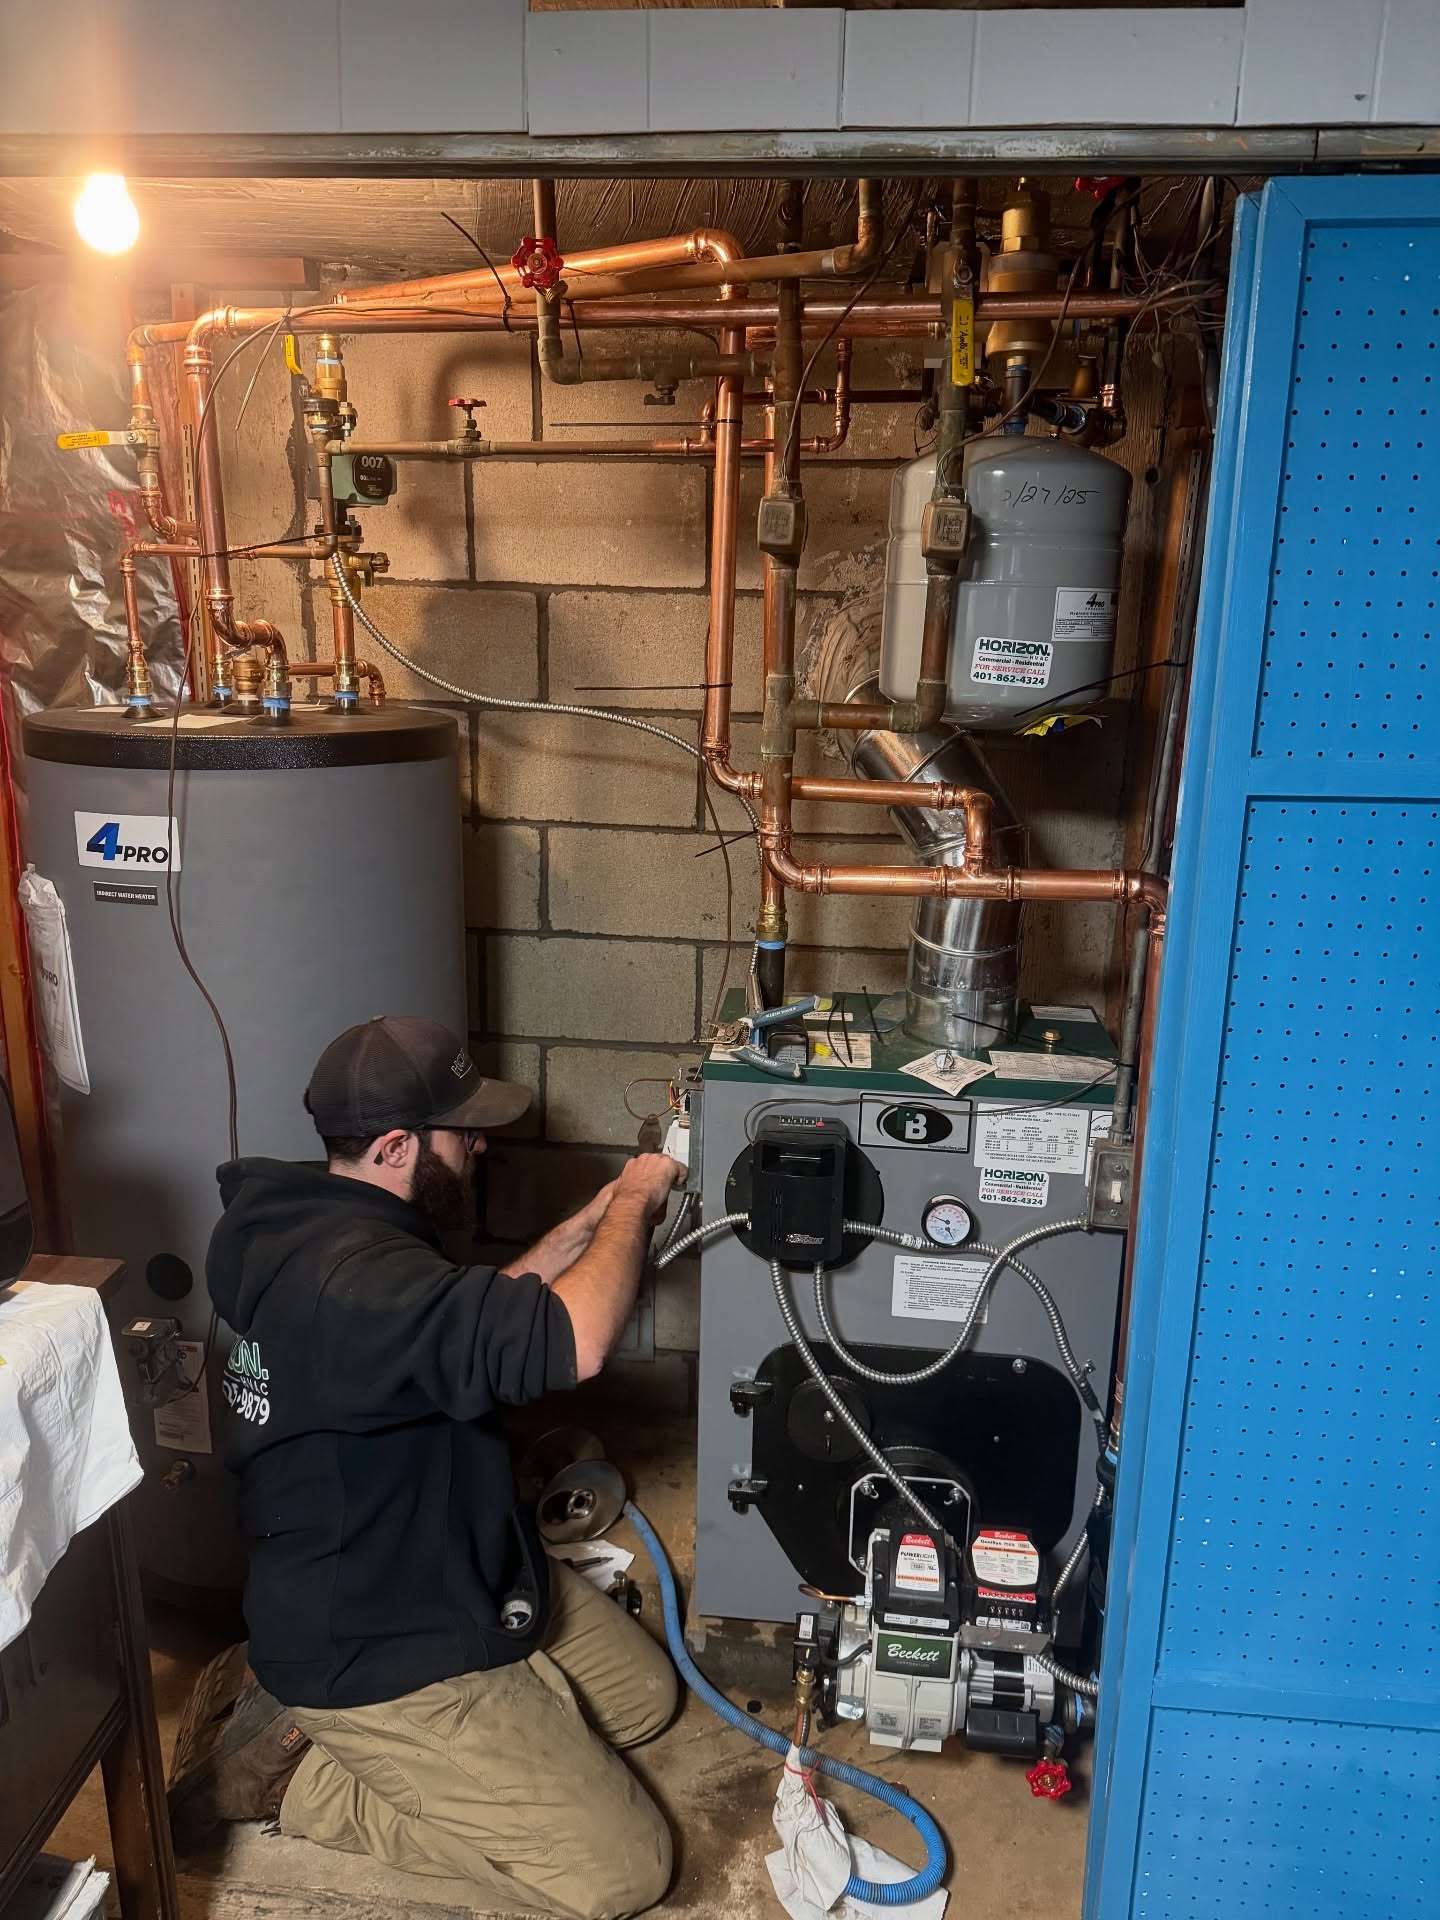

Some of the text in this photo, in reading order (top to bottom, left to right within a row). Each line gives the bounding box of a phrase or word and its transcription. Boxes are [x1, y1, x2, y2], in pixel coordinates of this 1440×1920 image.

[978, 656, 1012, 664] Commercial
[1014, 659, 1045, 667] Residential
[991, 665, 1026, 674] SERVICE
[1026, 668, 1046, 676] CALL
[973, 671, 1045, 685] 401-862-4324
[86, 822, 169, 864] 4PRO
[96, 890, 156, 900] INDIRECT WATER HEATER
[996, 1188, 1026, 1196] SERVICE
[981, 1193, 1043, 1205] 401-862-4324
[905, 1535, 932, 1546] Beckett
[993, 1531, 1017, 1540] Beckett
[887, 1643, 940, 1662] Beckett
